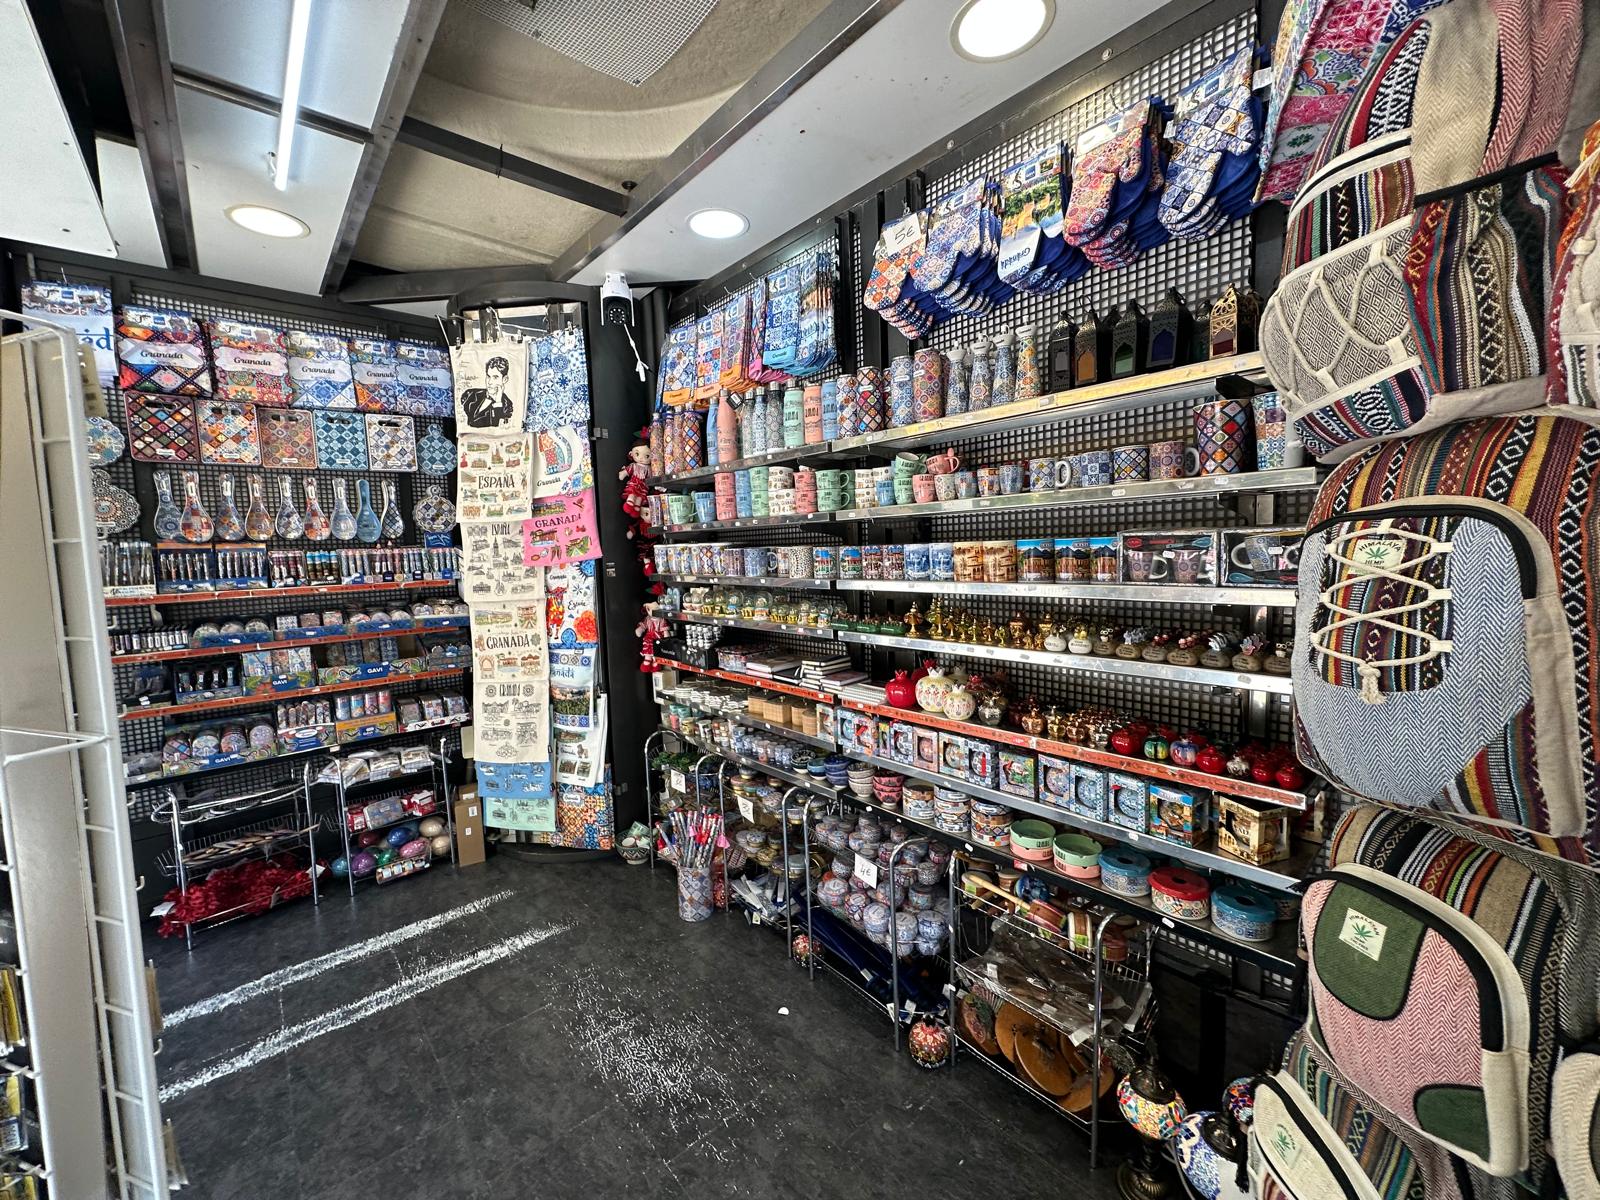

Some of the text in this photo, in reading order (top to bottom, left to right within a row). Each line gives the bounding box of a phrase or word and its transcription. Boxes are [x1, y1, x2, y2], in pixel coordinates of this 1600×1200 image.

[140, 350, 184, 359] Granada
[233, 356, 272, 366] Granada
[301, 365, 336, 375] Granada
[409, 374, 438, 382] Granada
[478, 474, 515, 489] ESPAÑA
[536, 476, 562, 487] Granada
[486, 633, 530, 650] GRANADA
